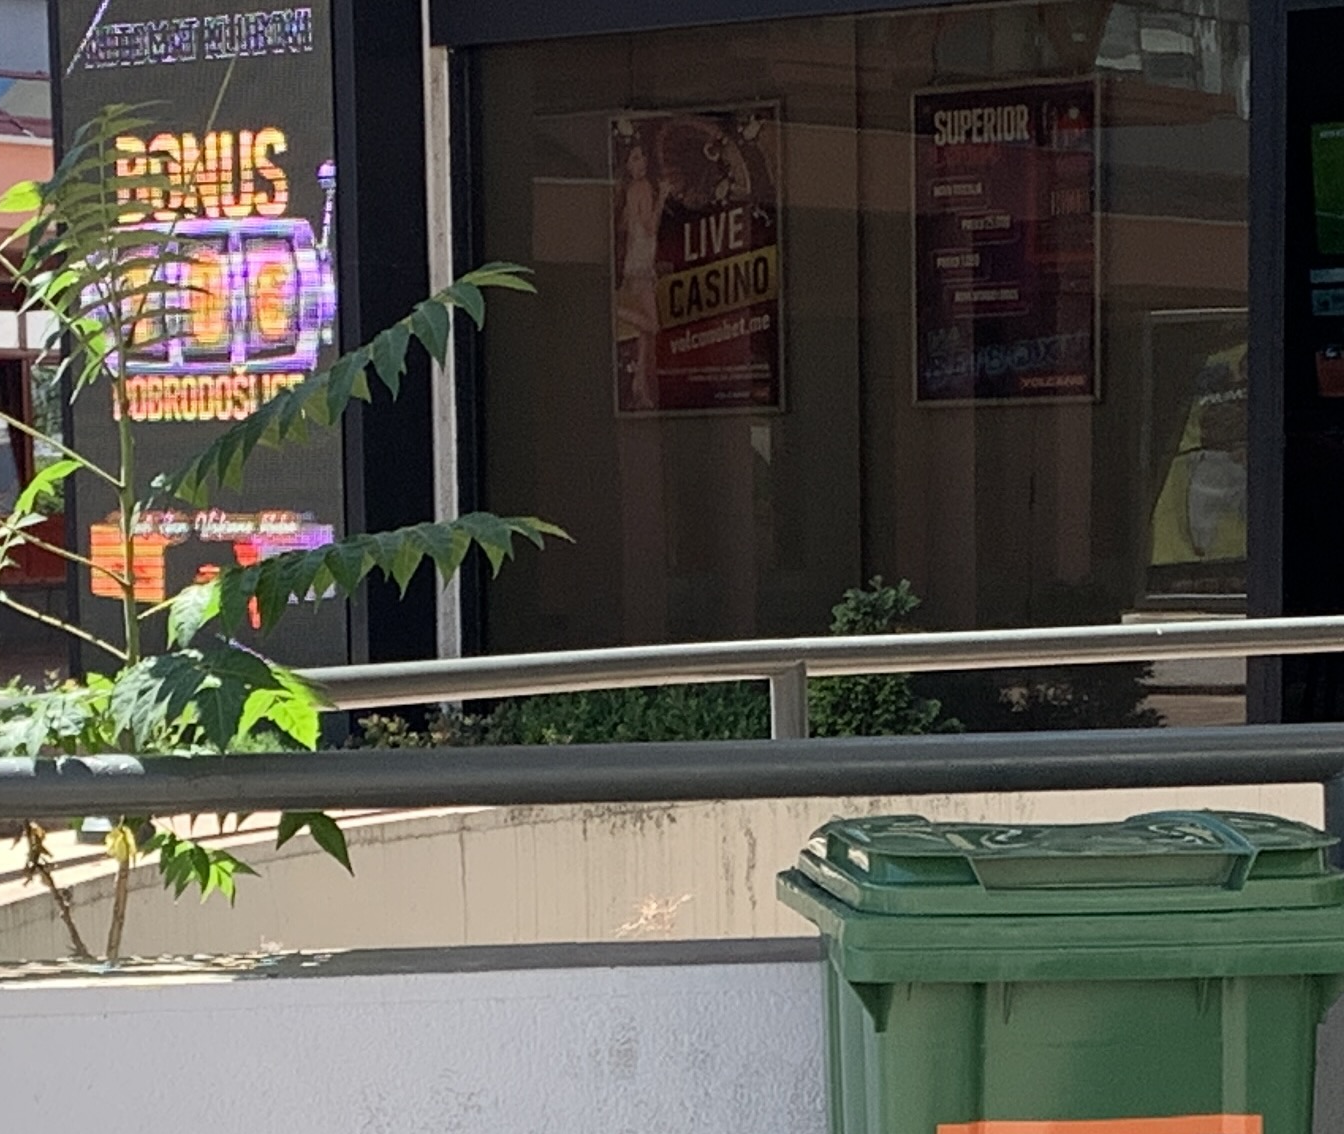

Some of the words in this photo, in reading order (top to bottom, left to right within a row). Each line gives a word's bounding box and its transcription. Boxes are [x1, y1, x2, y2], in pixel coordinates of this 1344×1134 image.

[934, 104, 1030, 147] SUPERIOR
[116, 127, 289, 223] BONUS
[684, 207, 745, 262] LIVE
[669, 256, 770, 319] CASINO
